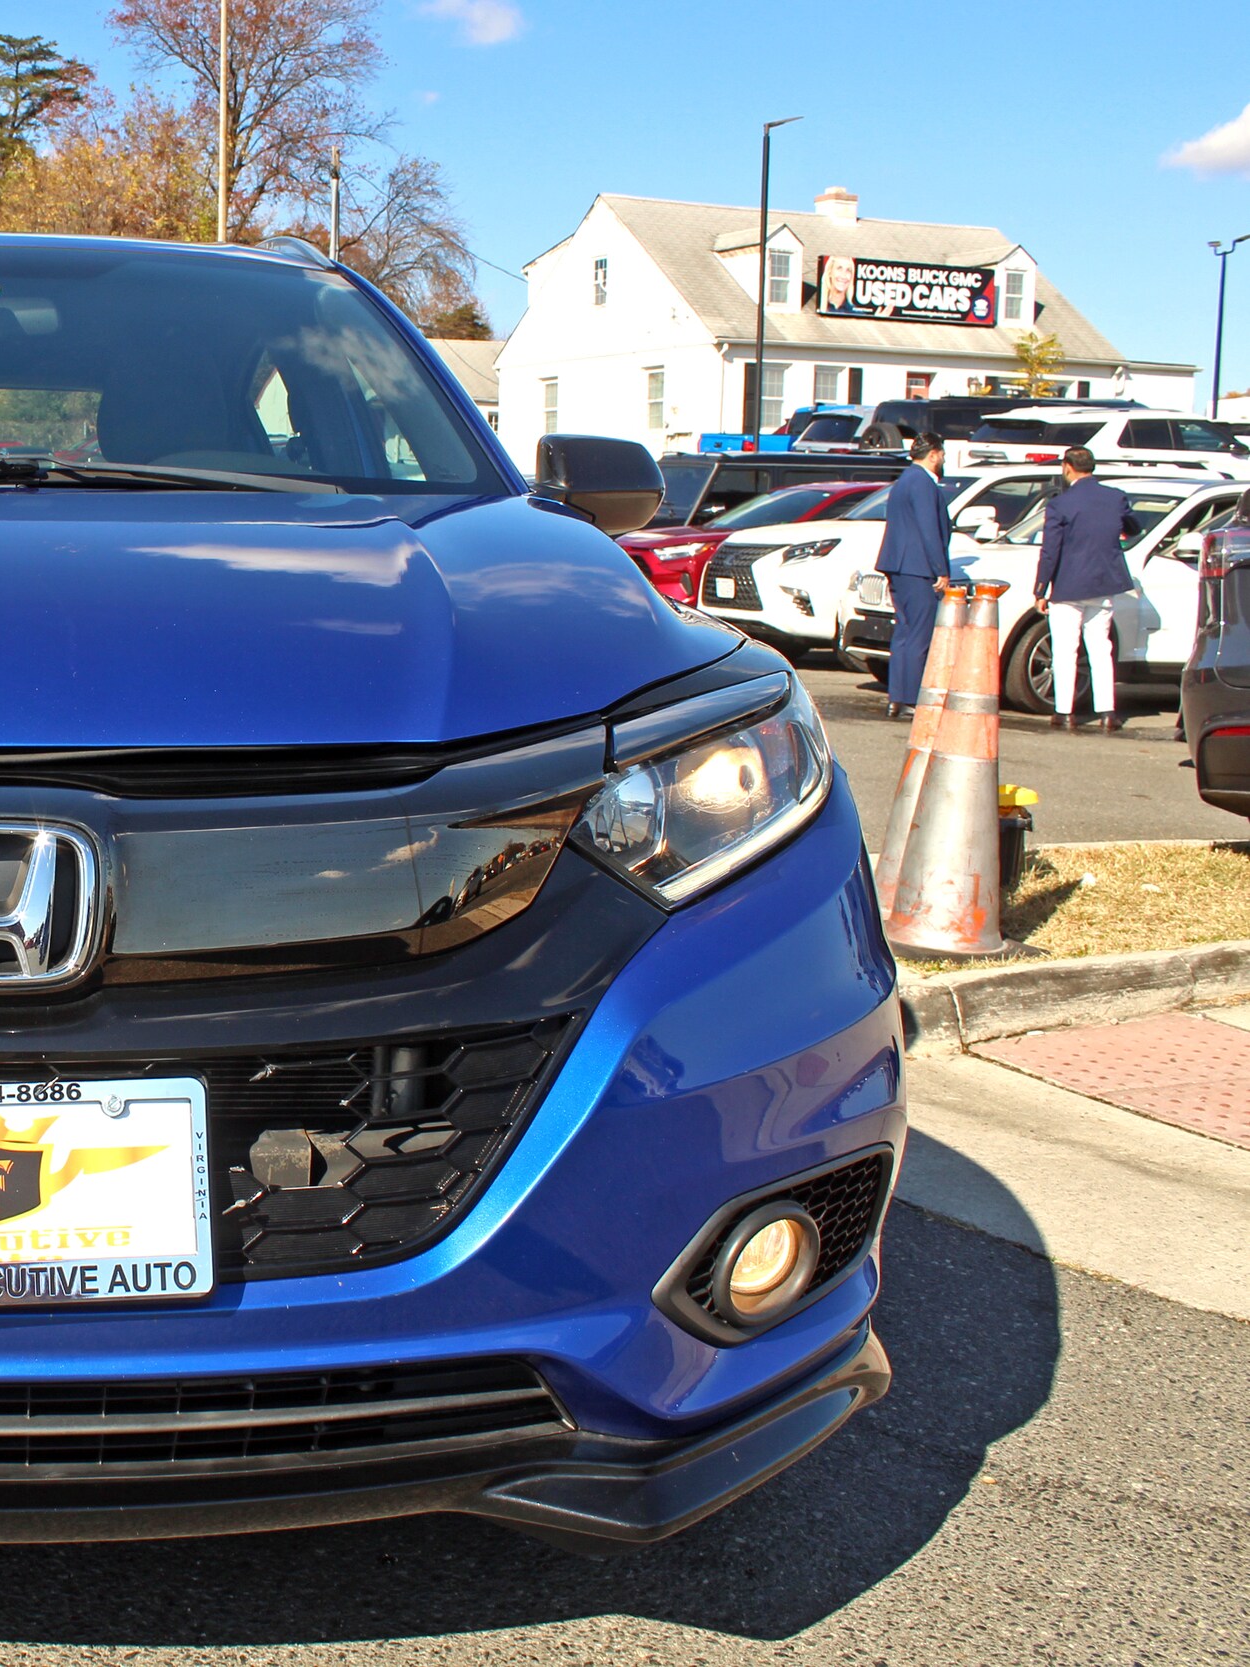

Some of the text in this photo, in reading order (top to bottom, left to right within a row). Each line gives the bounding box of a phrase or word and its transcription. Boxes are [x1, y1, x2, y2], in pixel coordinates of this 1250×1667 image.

[857, 264, 982, 288] KOONS BUICK GMC
[856, 280, 912, 307] USED
[912, 285, 971, 312] CARS
[195, 1131, 208, 1220] VIRGINIA
[108, 1260, 197, 1293] AUTO
